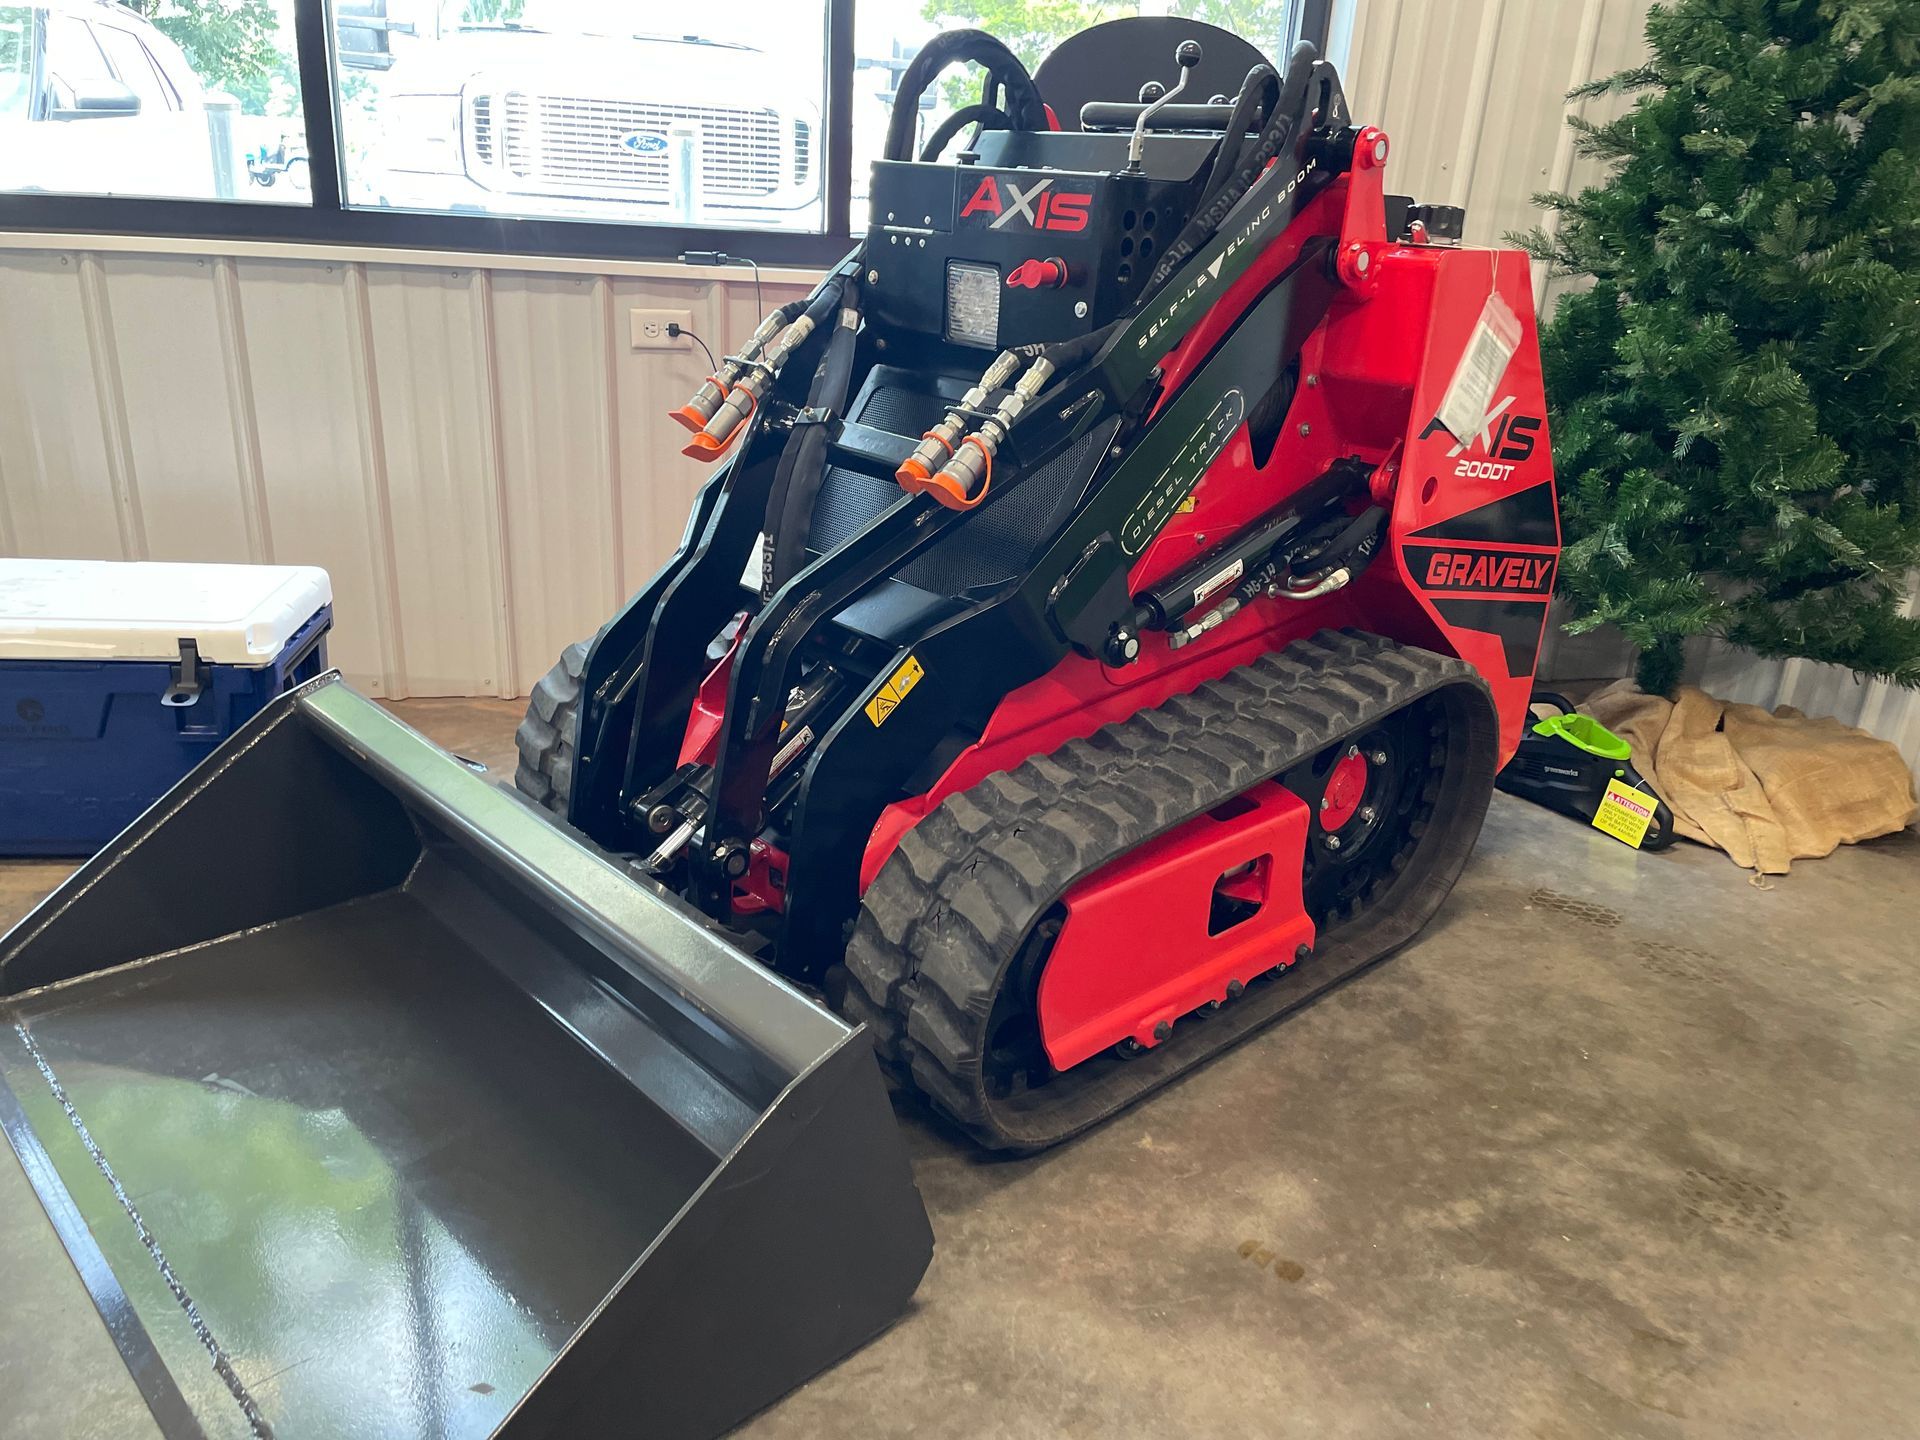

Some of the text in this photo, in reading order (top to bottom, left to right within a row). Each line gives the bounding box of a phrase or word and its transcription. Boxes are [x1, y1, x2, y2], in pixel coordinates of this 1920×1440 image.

[633, 135, 662, 152] Ford
[1277, 158, 1317, 203] BOOM
[960, 176, 1092, 232] AXIS
[1133, 407, 1233, 539] DIESEL TRACK
[1454, 459, 1515, 481] 200DT
[1426, 553, 1551, 589] GRAVELY
[1544, 766, 1579, 777] greenworks
